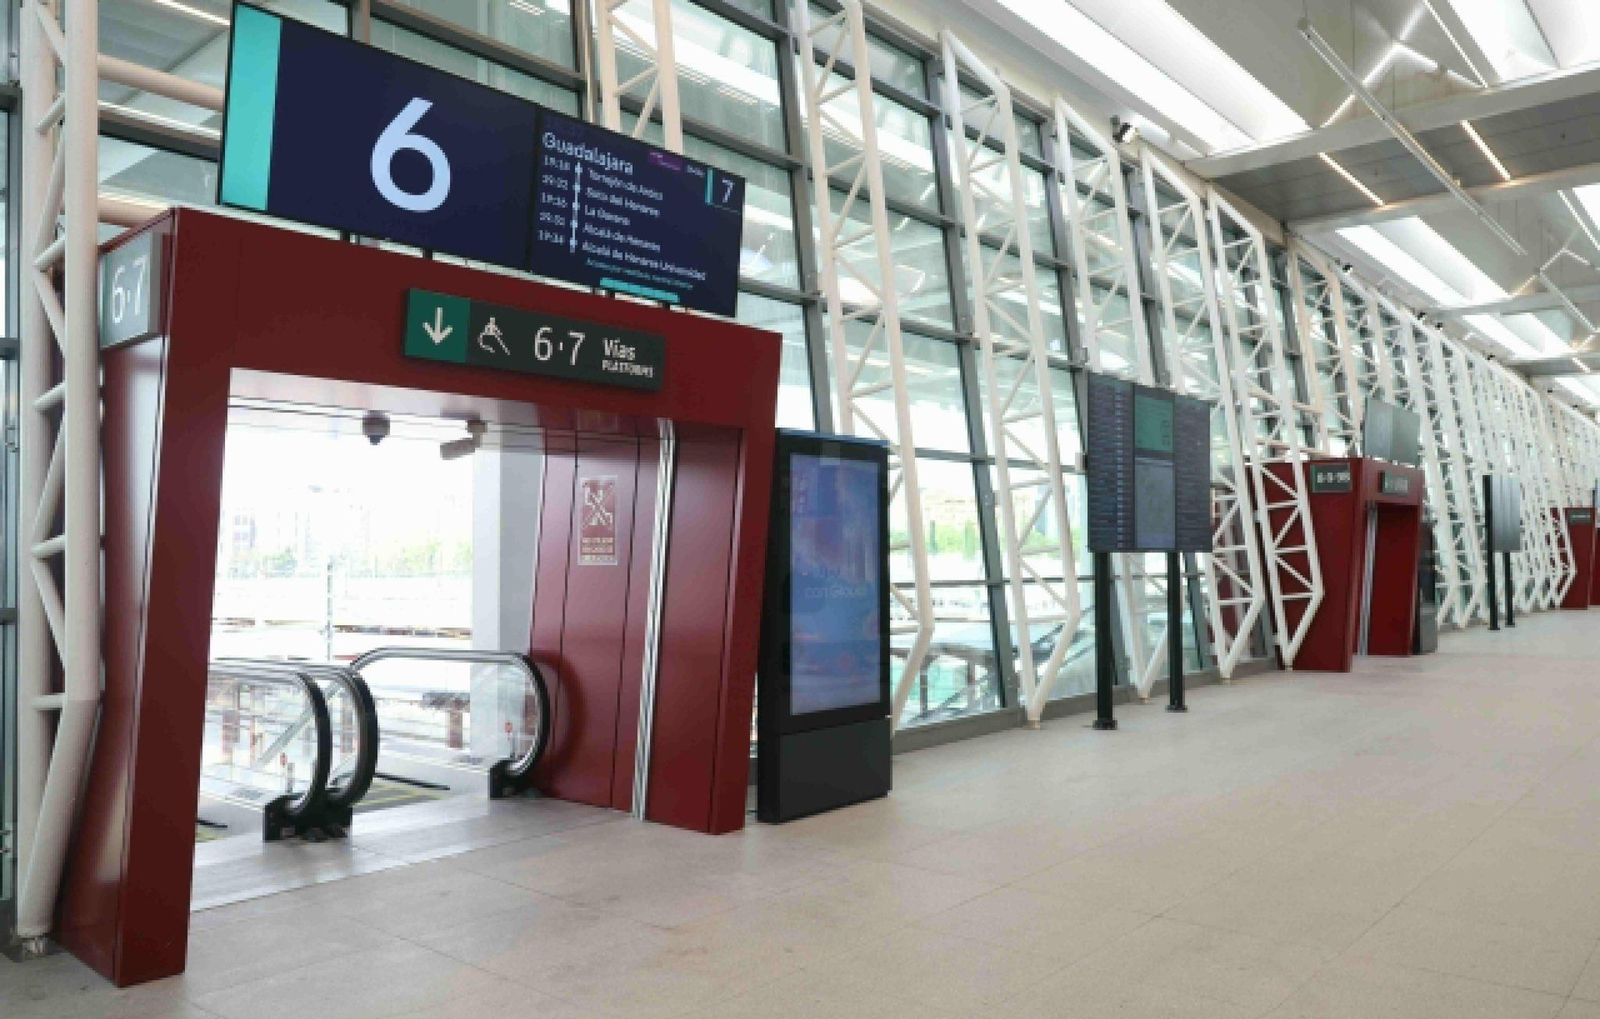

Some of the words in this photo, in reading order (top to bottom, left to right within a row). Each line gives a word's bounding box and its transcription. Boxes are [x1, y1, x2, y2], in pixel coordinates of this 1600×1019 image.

[370, 97, 452, 212] 6
[542, 132, 633, 175] Guadalajara
[721, 177, 735, 203] 7
[584, 204, 595, 216] La
